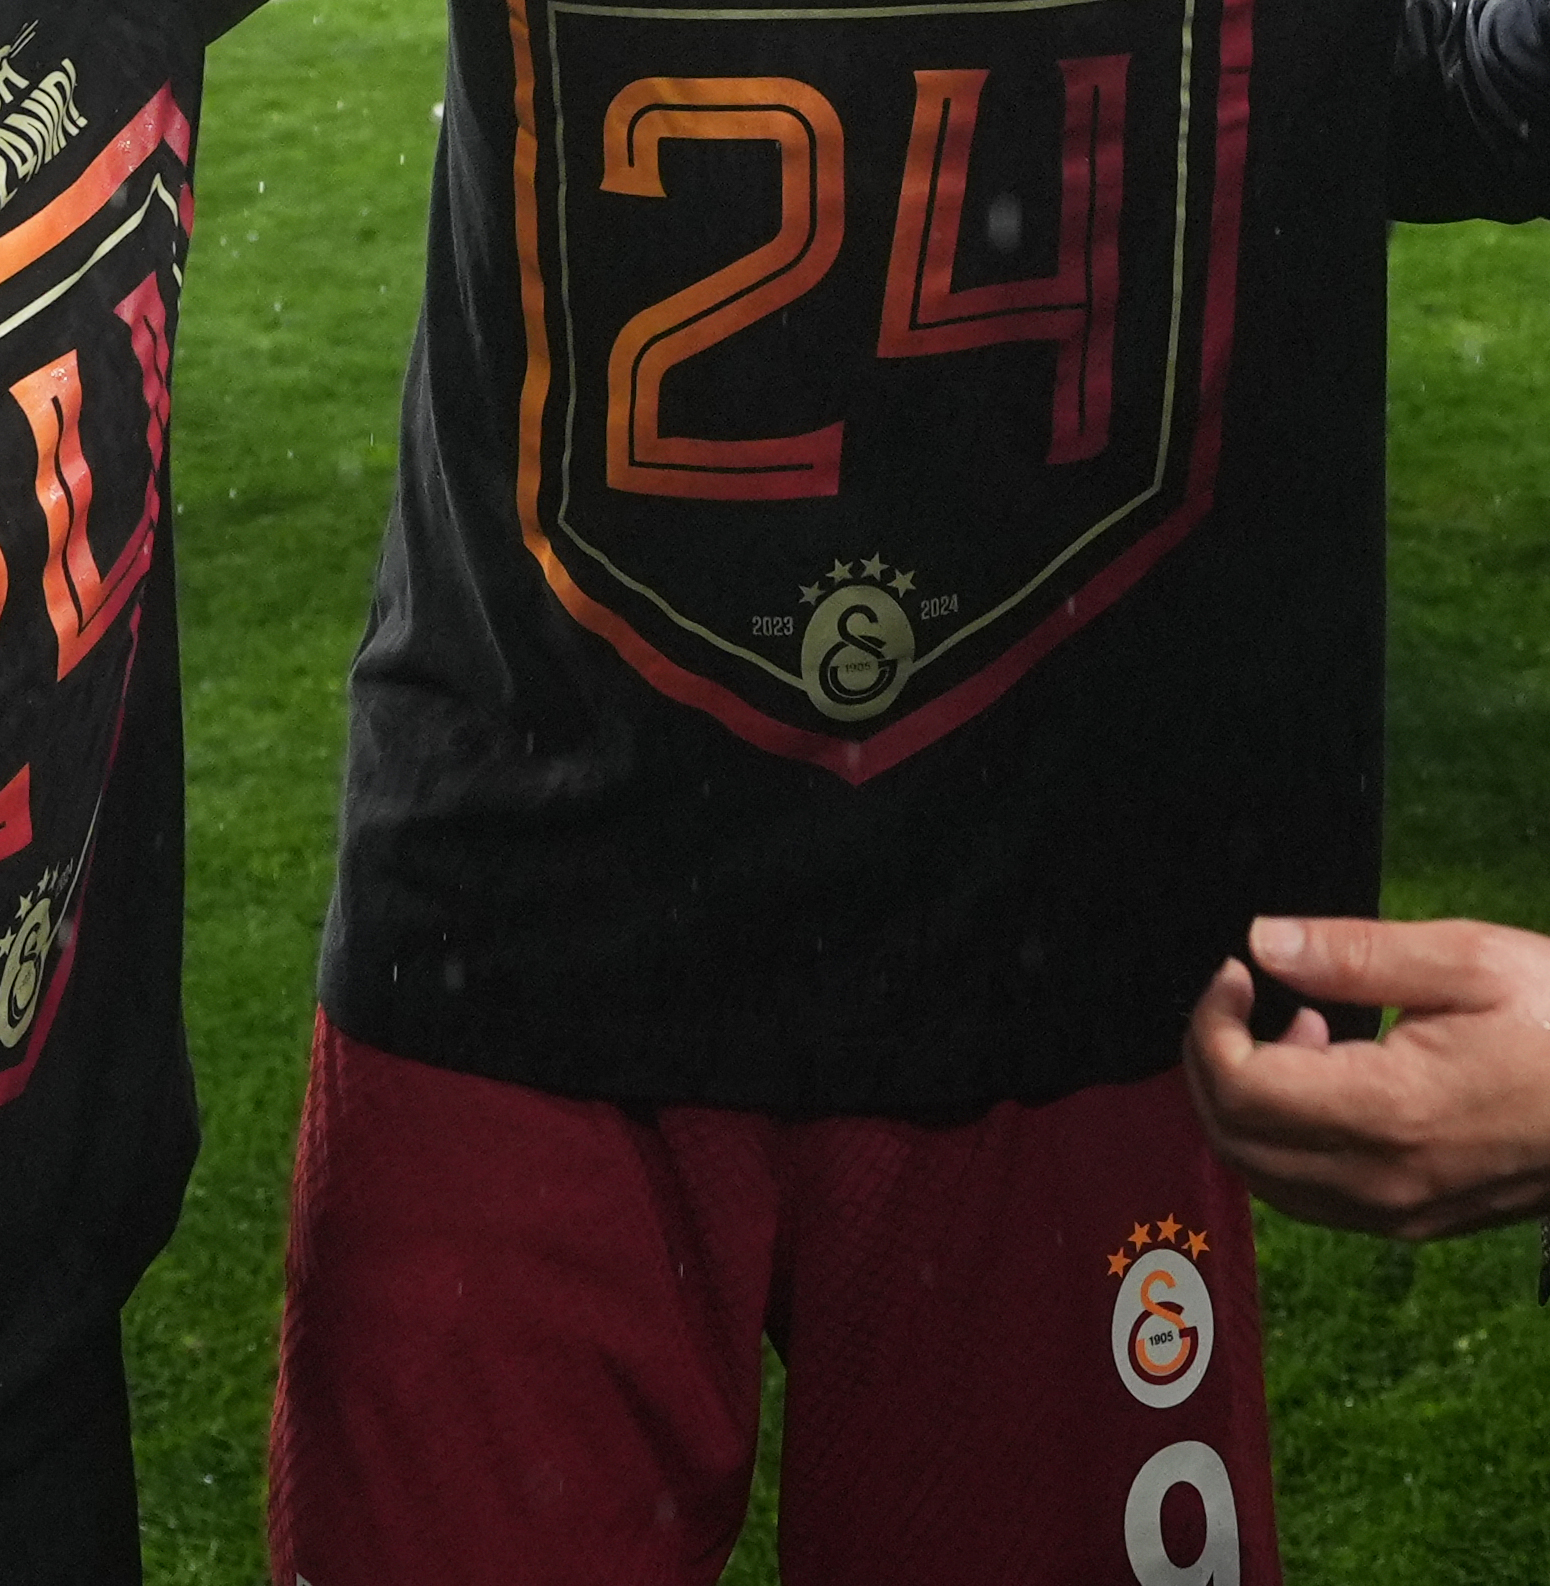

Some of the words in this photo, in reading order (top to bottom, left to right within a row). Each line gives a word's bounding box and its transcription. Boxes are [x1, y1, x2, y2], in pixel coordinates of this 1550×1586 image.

[599, 53, 1132, 501] 24
[752, 616, 794, 636] 2023
[920, 594, 959, 620] 2024
[1149, 1331, 1174, 1346] 1905
[1124, 1440, 1240, 1586] 9
